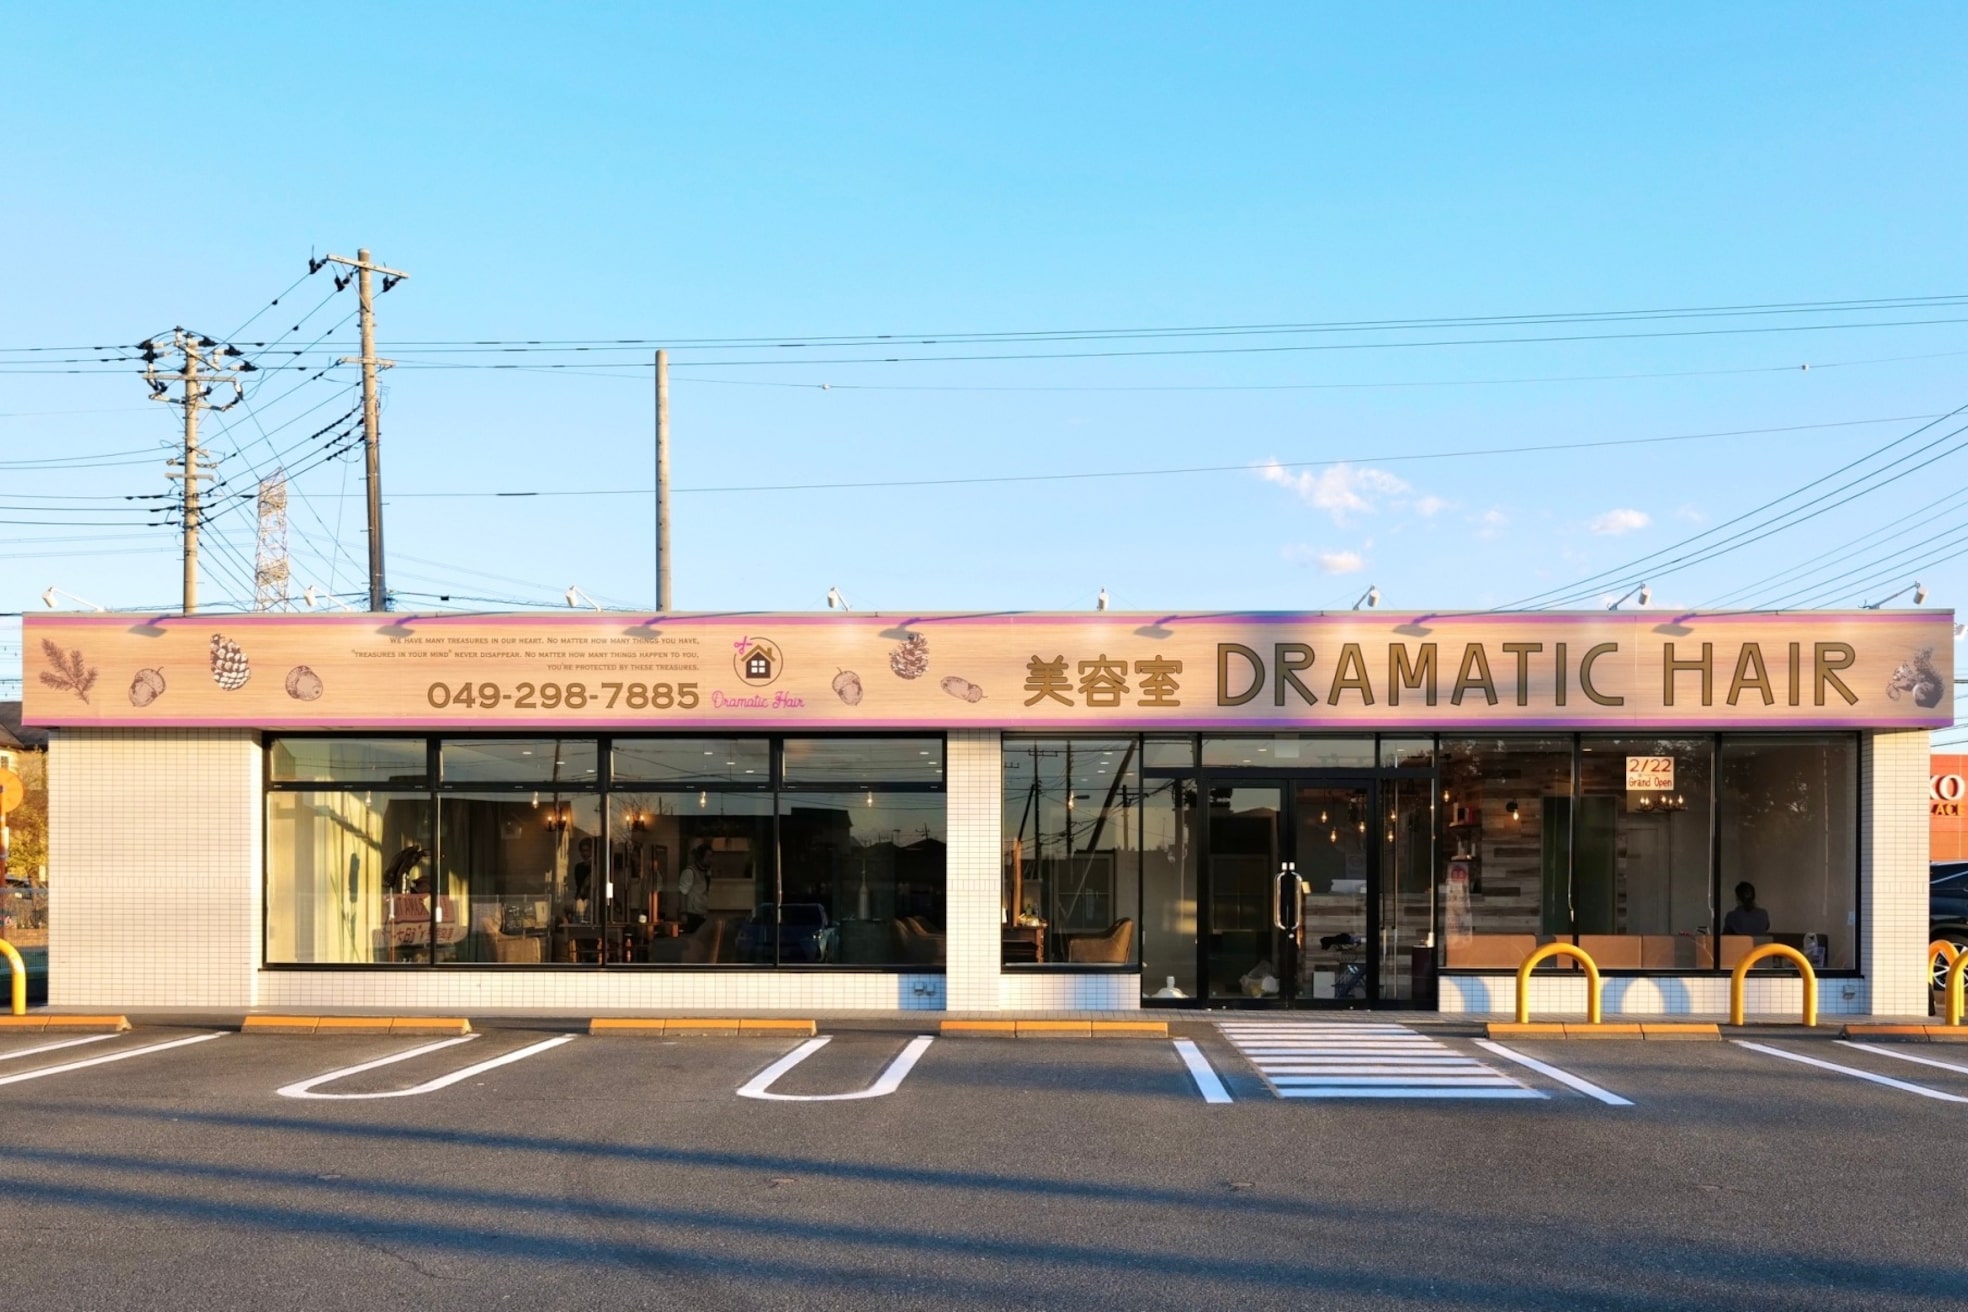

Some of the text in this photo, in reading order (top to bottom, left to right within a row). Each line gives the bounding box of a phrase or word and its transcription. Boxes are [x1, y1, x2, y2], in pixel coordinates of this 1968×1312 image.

[1023, 642, 1859, 707] 美容室 DRAMATIC HAIR
[427, 682, 699, 709] 049-298-7885
[711, 690, 805, 708] Dramatic Hair
[1629, 758, 1671, 773] 2/22
[1628, 776, 1673, 789] Grand Open
